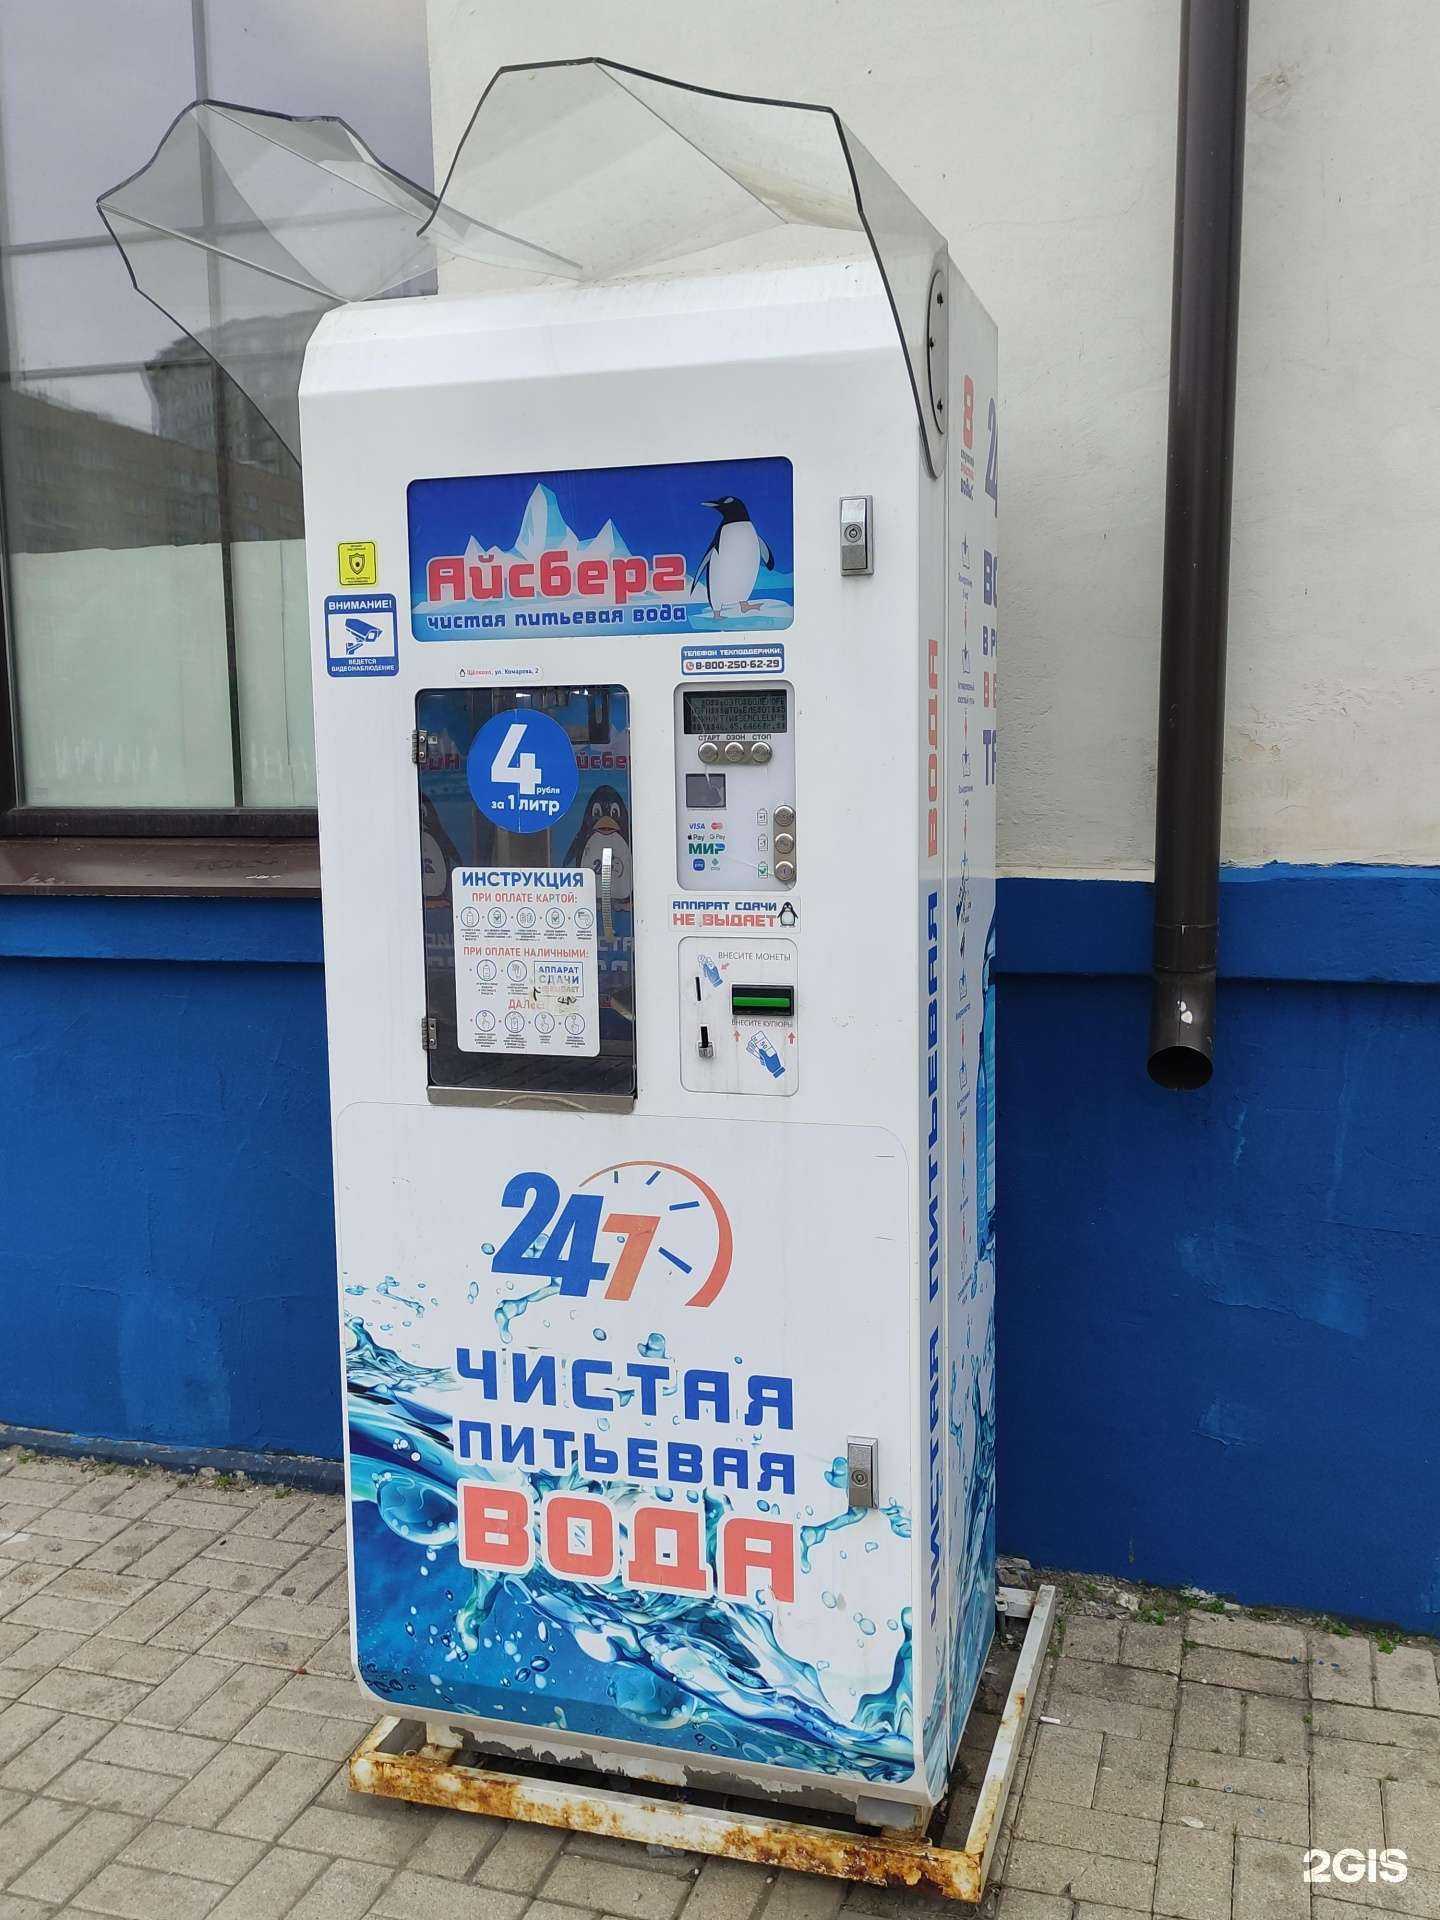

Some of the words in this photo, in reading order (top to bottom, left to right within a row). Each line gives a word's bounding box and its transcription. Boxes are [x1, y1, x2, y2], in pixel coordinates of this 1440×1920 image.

[428, 550, 685, 605] Айсберг
[328, 600, 392, 611] ВНИМАНИЕ!
[428, 613, 505, 630] чистая
[515, 608, 623, 628] питьевая
[634, 604, 686, 623] вода
[331, 664, 395, 673] ВИДЕОНАБЛЮДЕНИЕ
[348, 658, 377, 666] ВЕДЕТСЯ
[695, 660, 780, 670] 8-800-250-62-29
[928, 639, 938, 858] ВОДА
[491, 724, 542, 795] 4
[537, 786, 561, 796] рубля
[491, 801, 505, 810] за
[507, 795, 516, 810] 1
[519, 799, 560, 816] литр
[688, 822, 705, 830] VISA
[688, 842, 726, 855] МИР
[462, 871, 584, 889] ИНСТРУКЦИЯ
[472, 892, 492, 902] ПРИ
[495, 893, 533, 903] ОПЛАТЕ
[536, 892, 578, 903] КАРТОЙ:
[672, 901, 730, 911] АППАРАТ
[735, 901, 777, 911] СДАЧИ
[673, 913, 695, 926] НЕ
[702, 914, 777, 927] ВЫДАЕТ
[464, 946, 482, 955] ПРИ
[485, 947, 521, 957] ОПЛАТЕ
[524, 948, 589, 958] НАЛИЧНЫМИ:
[718, 951, 753, 961] ВНЕСИТЕ
[755, 953, 791, 962] МОНЕТЫ
[538, 966, 579, 974] АППАРАТ
[731, 1019, 762, 1028] ВНЕСИТЕ
[928, 890, 939, 1304] ПИТЬЕВАЯ
[456, 1348, 794, 1430] ЧИСТАЯ
[458, 1419, 796, 1495] ПИТЬЕВАЯ
[928, 1325, 940, 1630] ЧИСТАЯ
[462, 1484, 795, 1603] ВОДА
